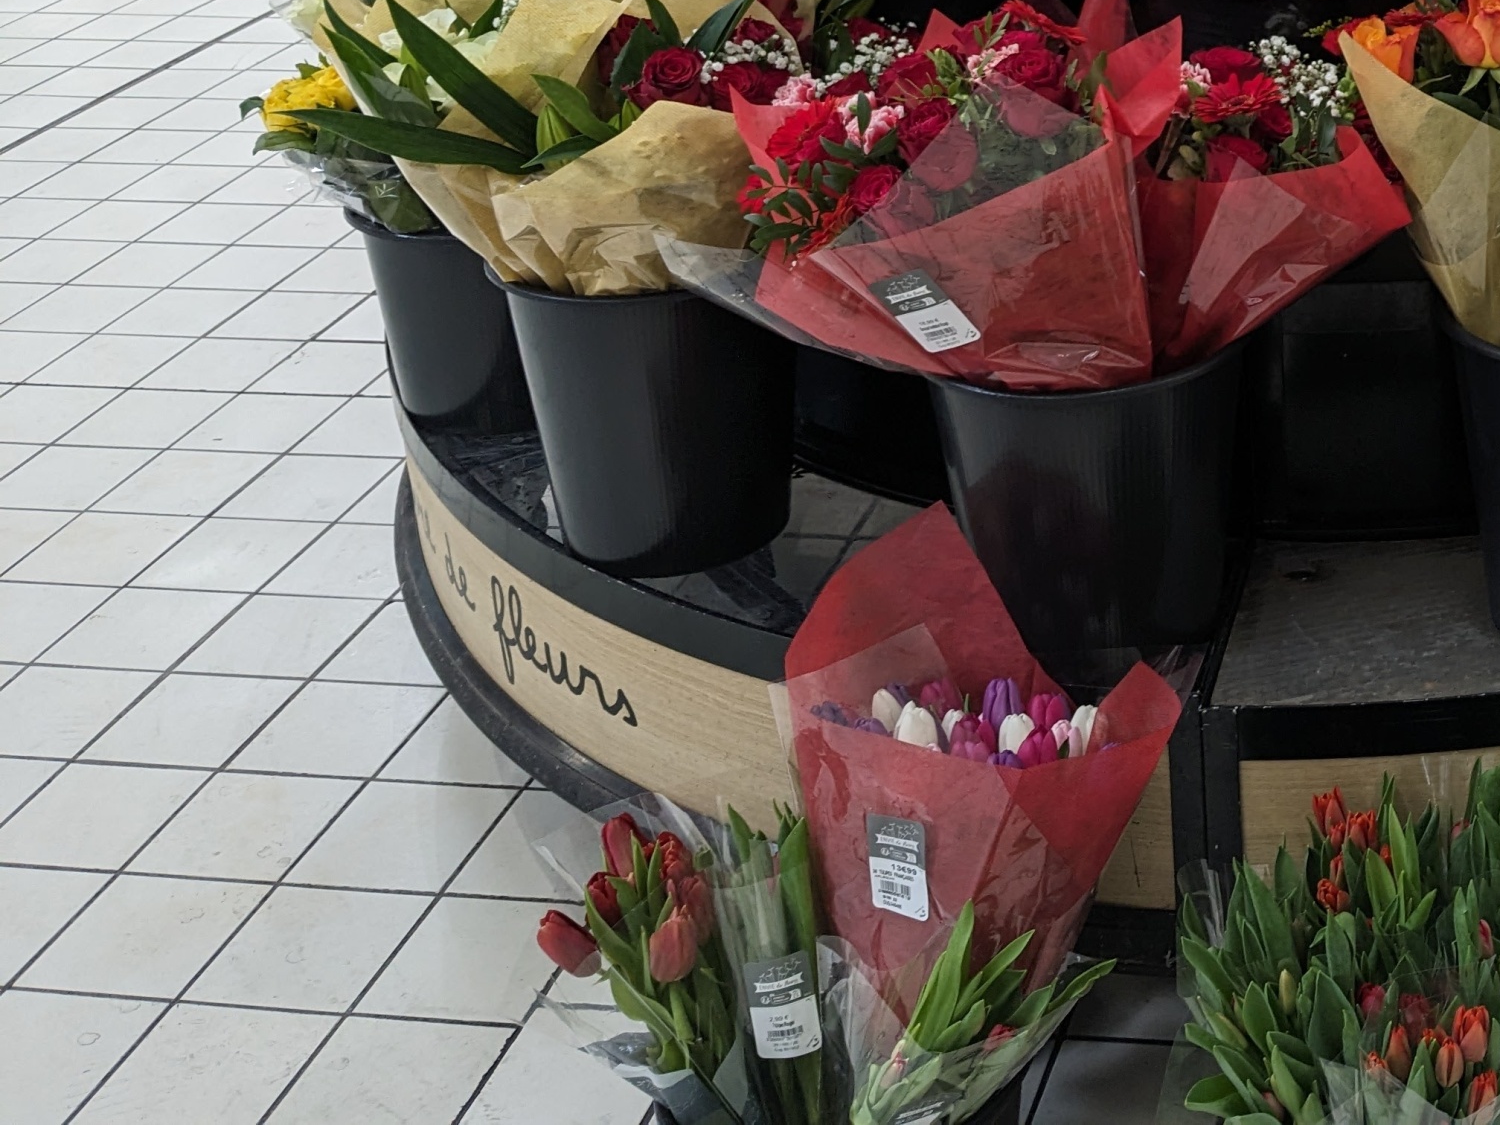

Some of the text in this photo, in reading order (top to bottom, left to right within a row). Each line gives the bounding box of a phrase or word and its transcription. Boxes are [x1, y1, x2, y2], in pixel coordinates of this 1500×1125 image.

[445, 532, 638, 727] de fleurs
[891, 864, 918, 876] 13€99
